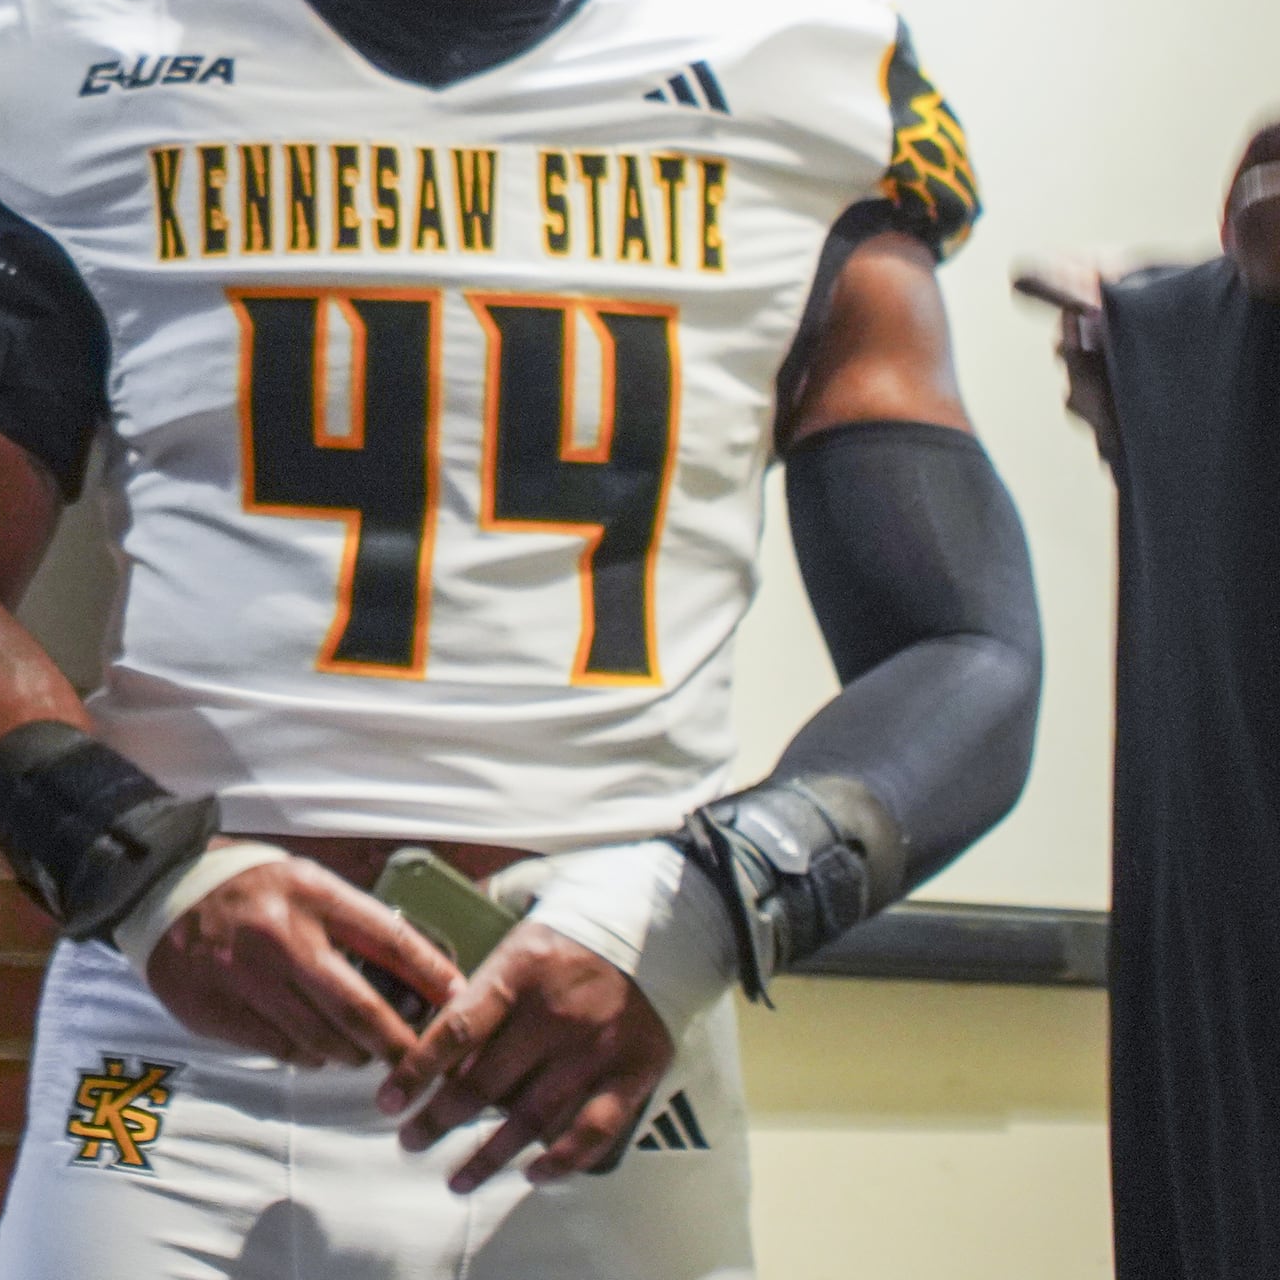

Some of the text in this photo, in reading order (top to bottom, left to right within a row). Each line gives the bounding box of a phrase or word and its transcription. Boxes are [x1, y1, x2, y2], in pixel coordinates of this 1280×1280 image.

[149, 143, 731, 274] KENNESAW STATE
[223, 285, 680, 688] 44
